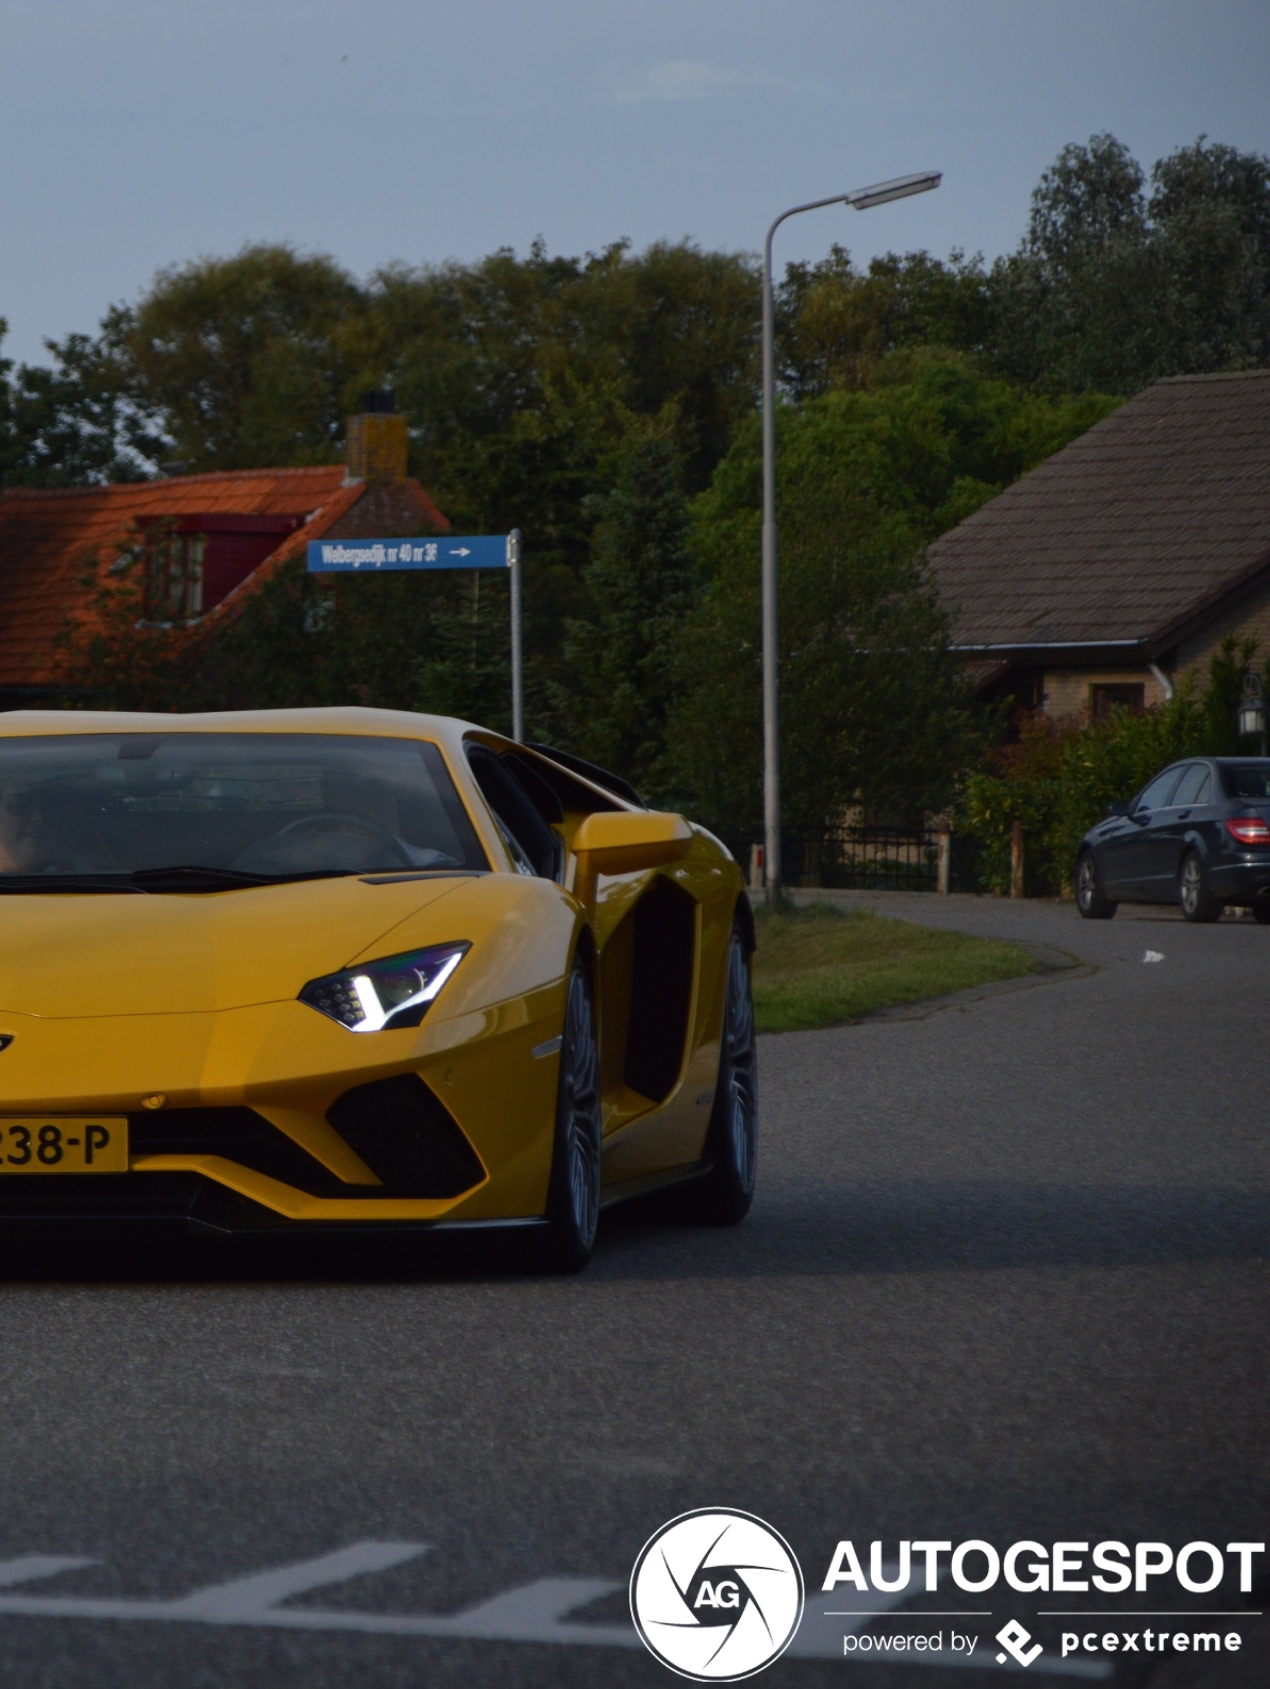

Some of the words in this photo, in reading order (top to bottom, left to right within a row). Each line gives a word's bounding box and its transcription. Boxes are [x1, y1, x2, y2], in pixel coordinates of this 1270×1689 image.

[388, 548, 398, 562] nr
[399, 543, 412, 562] 40
[413, 547, 424, 562] nr
